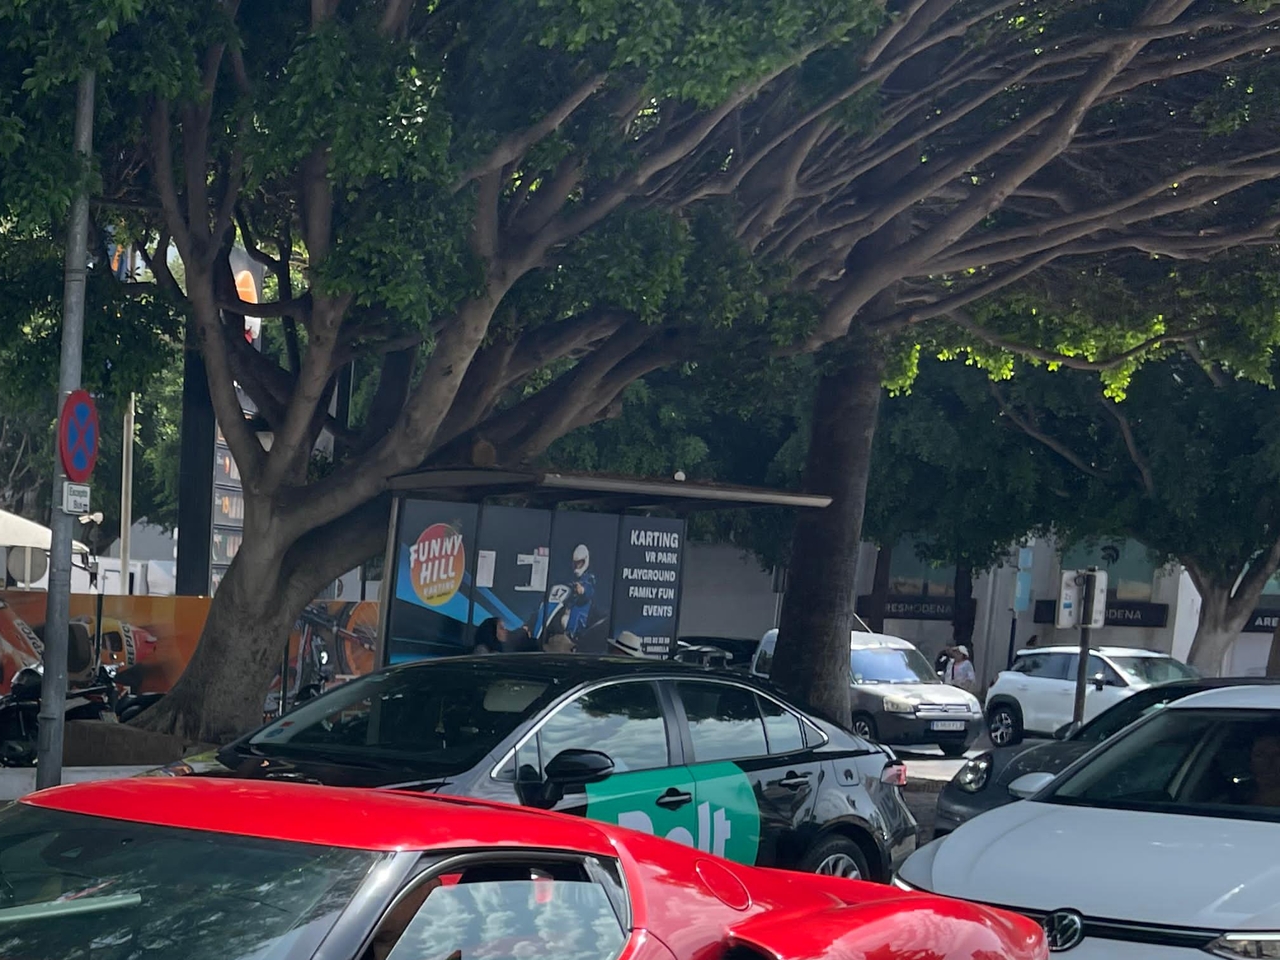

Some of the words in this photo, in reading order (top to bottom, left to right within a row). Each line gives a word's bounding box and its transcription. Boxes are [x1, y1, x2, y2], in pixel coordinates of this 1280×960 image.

[630, 529, 679, 549] KARTING
[410, 534, 463, 569] FUNNY
[645, 551, 656, 563] VR
[657, 552, 677, 565] PARK
[420, 555, 456, 585] HILL
[622, 567, 676, 582] PLAYGROUND
[629, 586, 657, 599] FAMILY
[658, 587, 675, 600] FUN
[642, 604, 673, 617] EVENTS
